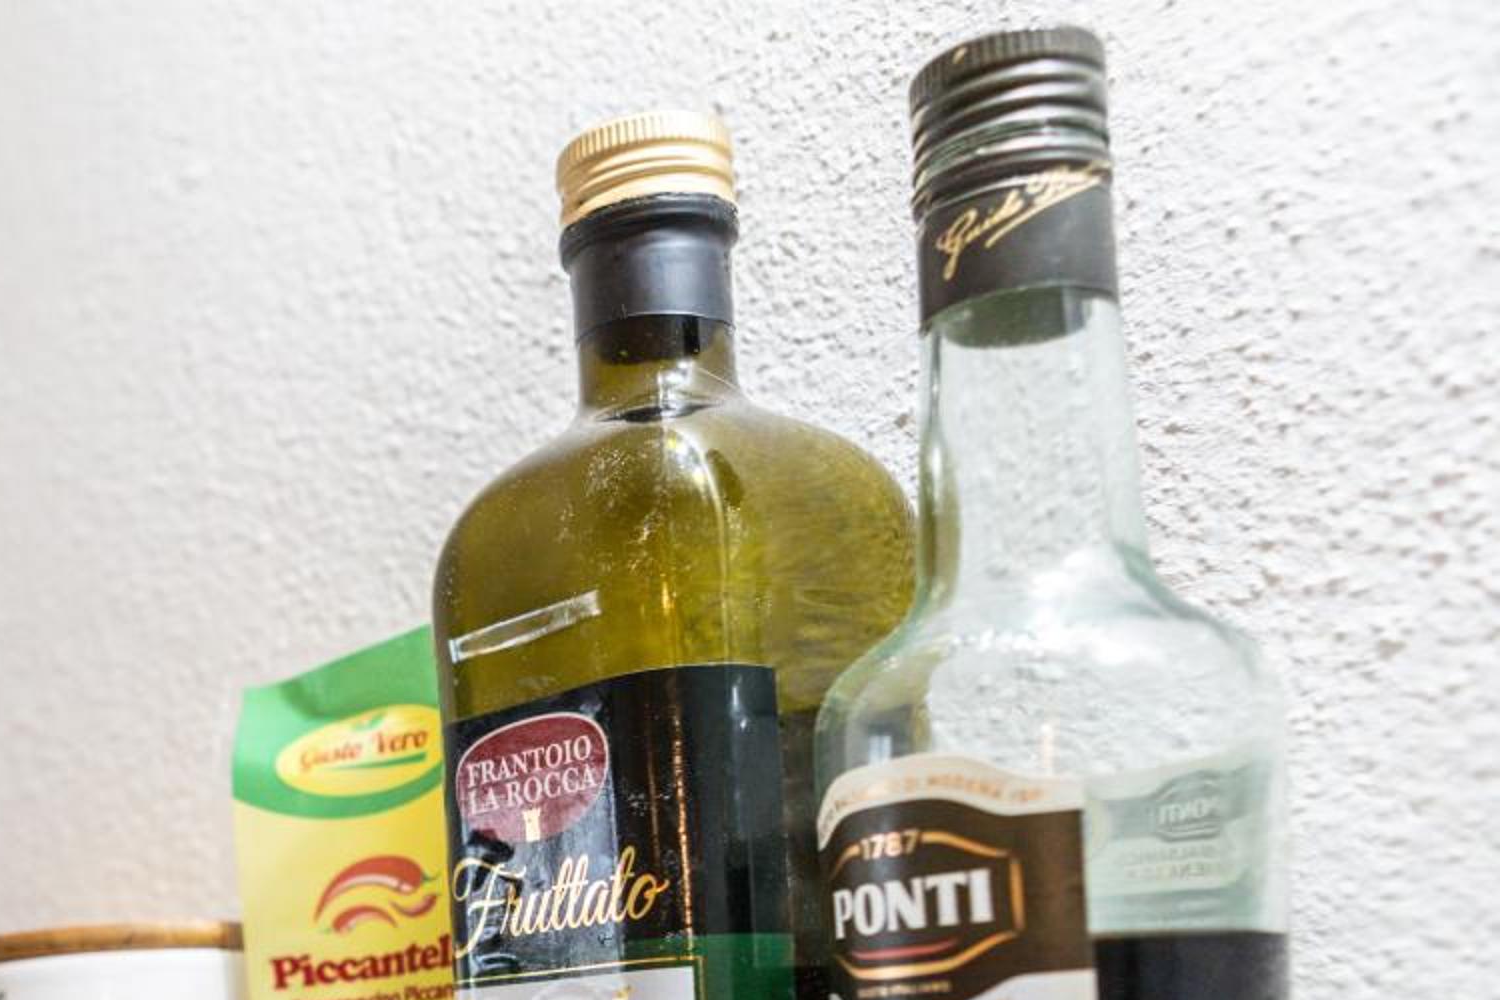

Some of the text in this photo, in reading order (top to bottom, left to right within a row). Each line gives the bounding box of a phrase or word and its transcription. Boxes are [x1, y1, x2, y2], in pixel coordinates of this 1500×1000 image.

[467, 734, 593, 788] FRANTOIO
[468, 763, 599, 815] LA ROCCA
[861, 828, 919, 860] 1787
[452, 845, 670, 959] Fruttato
[833, 867, 994, 940] PONTI
[270, 932, 453, 990] Piccantel
